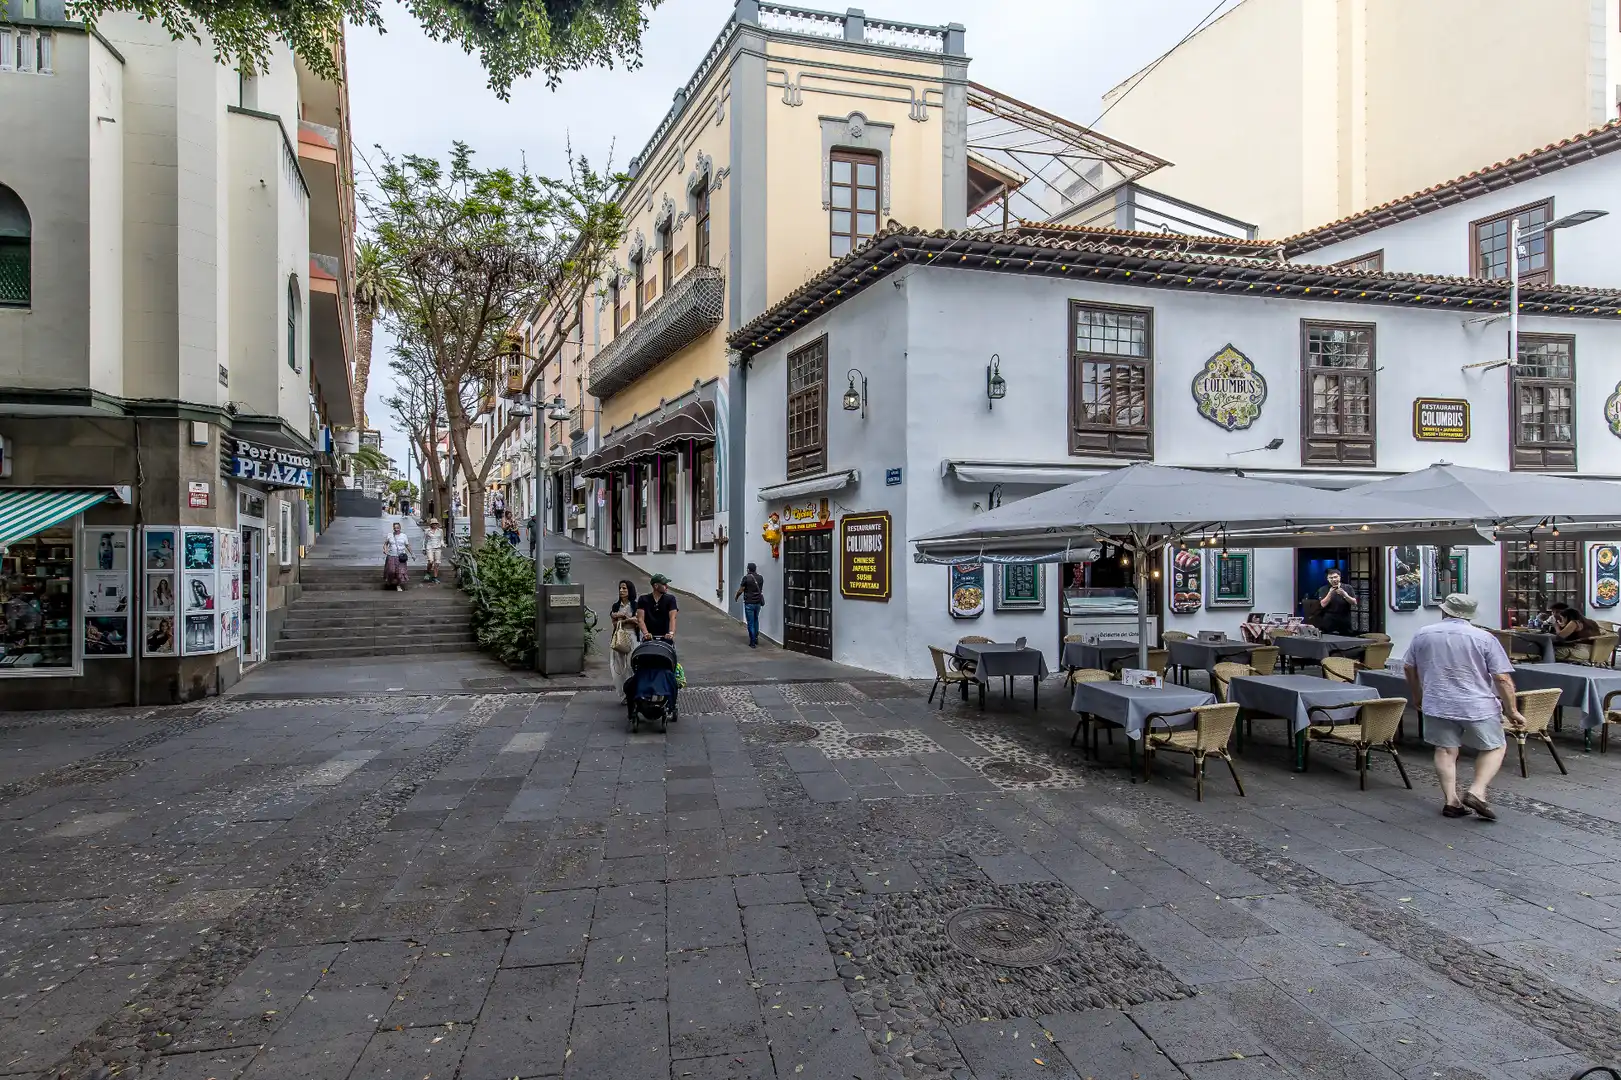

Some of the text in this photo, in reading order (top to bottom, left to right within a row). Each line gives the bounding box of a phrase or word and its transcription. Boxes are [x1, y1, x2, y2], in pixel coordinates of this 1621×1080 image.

[1204, 378, 1255, 394] COLUMBUS
[1422, 411, 1463, 426] COLUMBUS
[236, 440, 311, 468] Perfume
[237, 457, 312, 488] PLAZA
[847, 523, 882, 532] RESTAURANTE
[846, 534, 882, 552] COLUMBUS
[853, 556, 876, 564] CHINESE
[851, 564, 877, 573] JAPANESE
[856, 573, 873, 581] SUSHI
